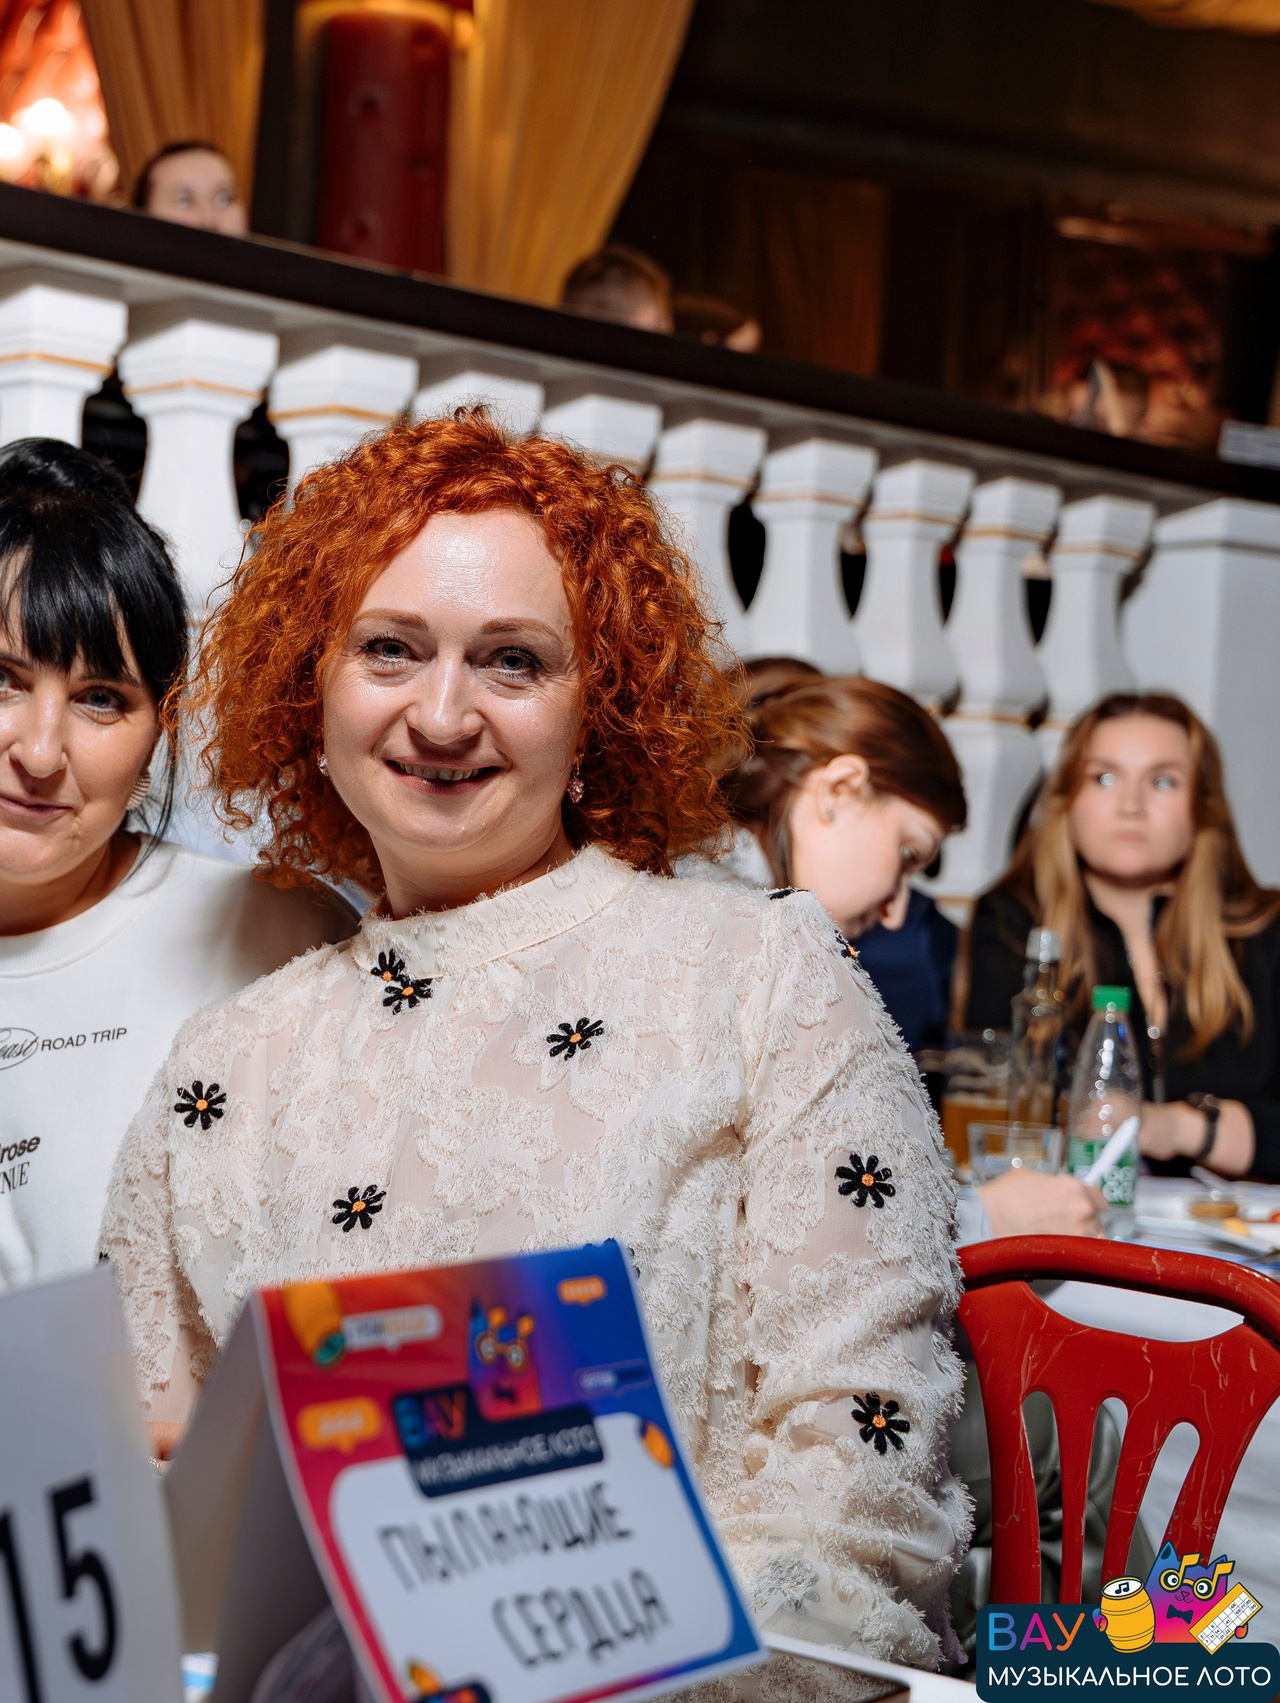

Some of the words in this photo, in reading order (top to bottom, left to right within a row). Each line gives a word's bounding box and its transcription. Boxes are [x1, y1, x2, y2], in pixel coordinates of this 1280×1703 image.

[41, 1033, 87, 1052] ROAD
[91, 1027, 128, 1046] TRIP
[398, 1389, 467, 1450] ВАУ
[413, 1432, 547, 1486] МУЗЫКАЛЬНОЕ
[545, 1423, 600, 1460] ЛОТО
[376, 1479, 637, 1594] ПЫЛАЮЩИЕ
[491, 1566, 674, 1669] СЕРДЦА
